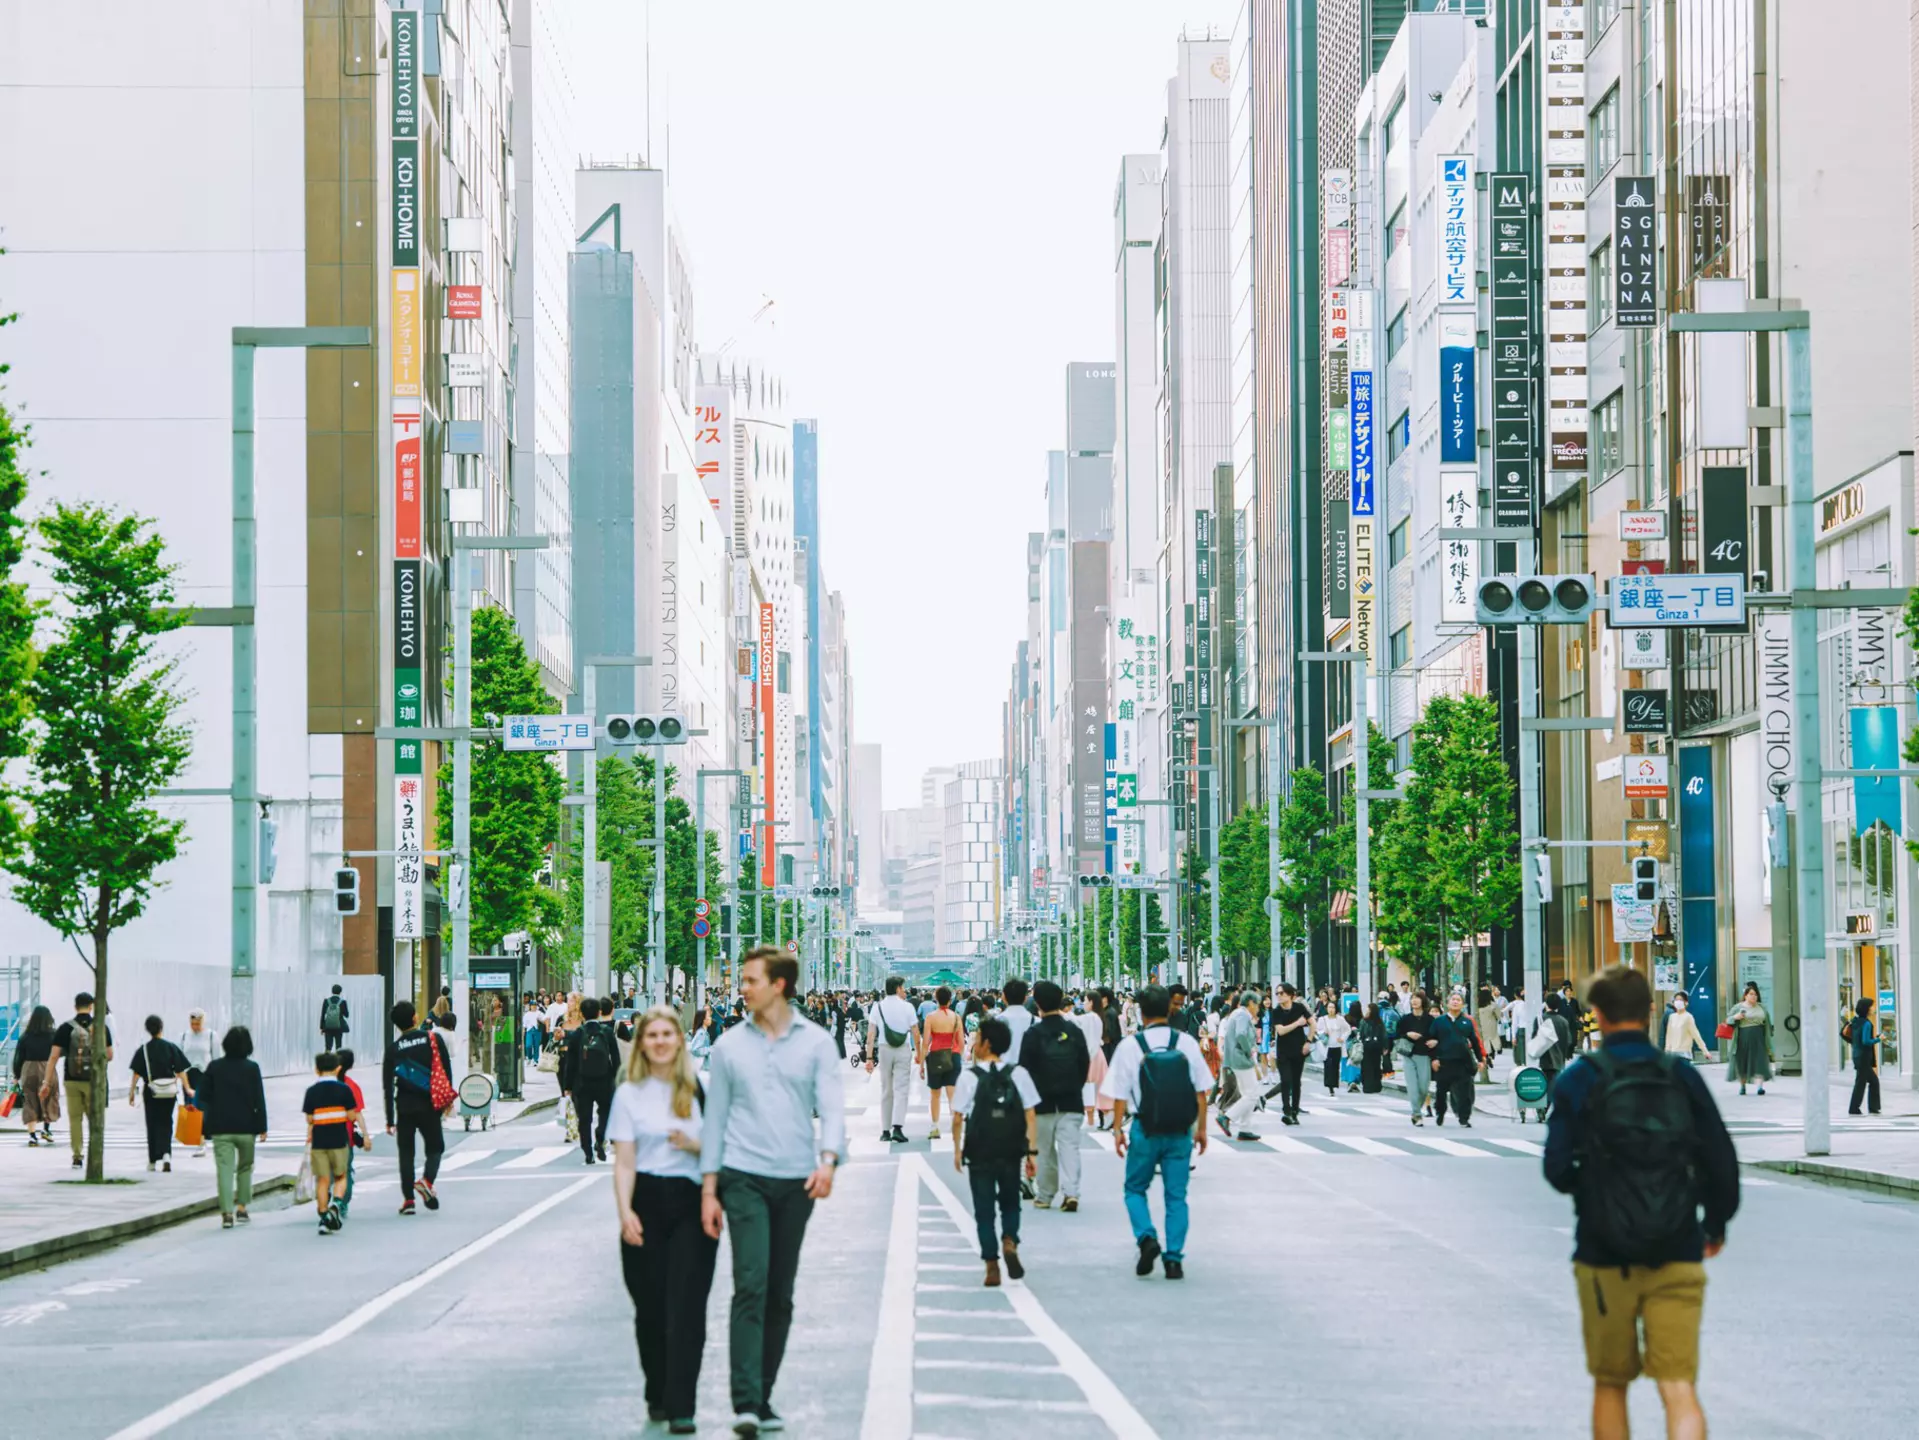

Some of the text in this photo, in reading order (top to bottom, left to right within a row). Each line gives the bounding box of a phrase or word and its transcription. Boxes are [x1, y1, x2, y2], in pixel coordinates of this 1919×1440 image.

[398, 18, 412, 106] KOMEHYO
[1562, 65, 1573, 73] 9F
[1562, 97, 1573, 105] 9F
[398, 157, 413, 249] KDI-HOME
[1328, 194, 1348, 203] TCB
[1563, 203, 1574, 211] 7F
[1446, 184, 1466, 300] テック航空サービス
[1620, 216, 1633, 303] SALON
[1640, 216, 1652, 303] GINZA
[1564, 301, 1574, 309] 5F
[1565, 367, 1575, 375] 4F
[1336, 530, 1346, 591] I-PRIMO
[1357, 524, 1370, 576] ELITE
[1619, 576, 1655, 587] 中央区
[1619, 587, 1734, 608] 銀座一丁目
[400, 569, 414, 657] KOMEHYO
[1656, 608, 1699, 620] Ginza 1
[762, 608, 772, 686] MITSUKOSHI
[1118, 618, 1134, 720] 教文館
[1764, 630, 1790, 703] JIMMY
[400, 706, 416, 759] 珈館
[510, 724, 589, 738] 銀座一丁目
[535, 738, 557, 746] Ginza
[1118, 779, 1135, 802] 本
